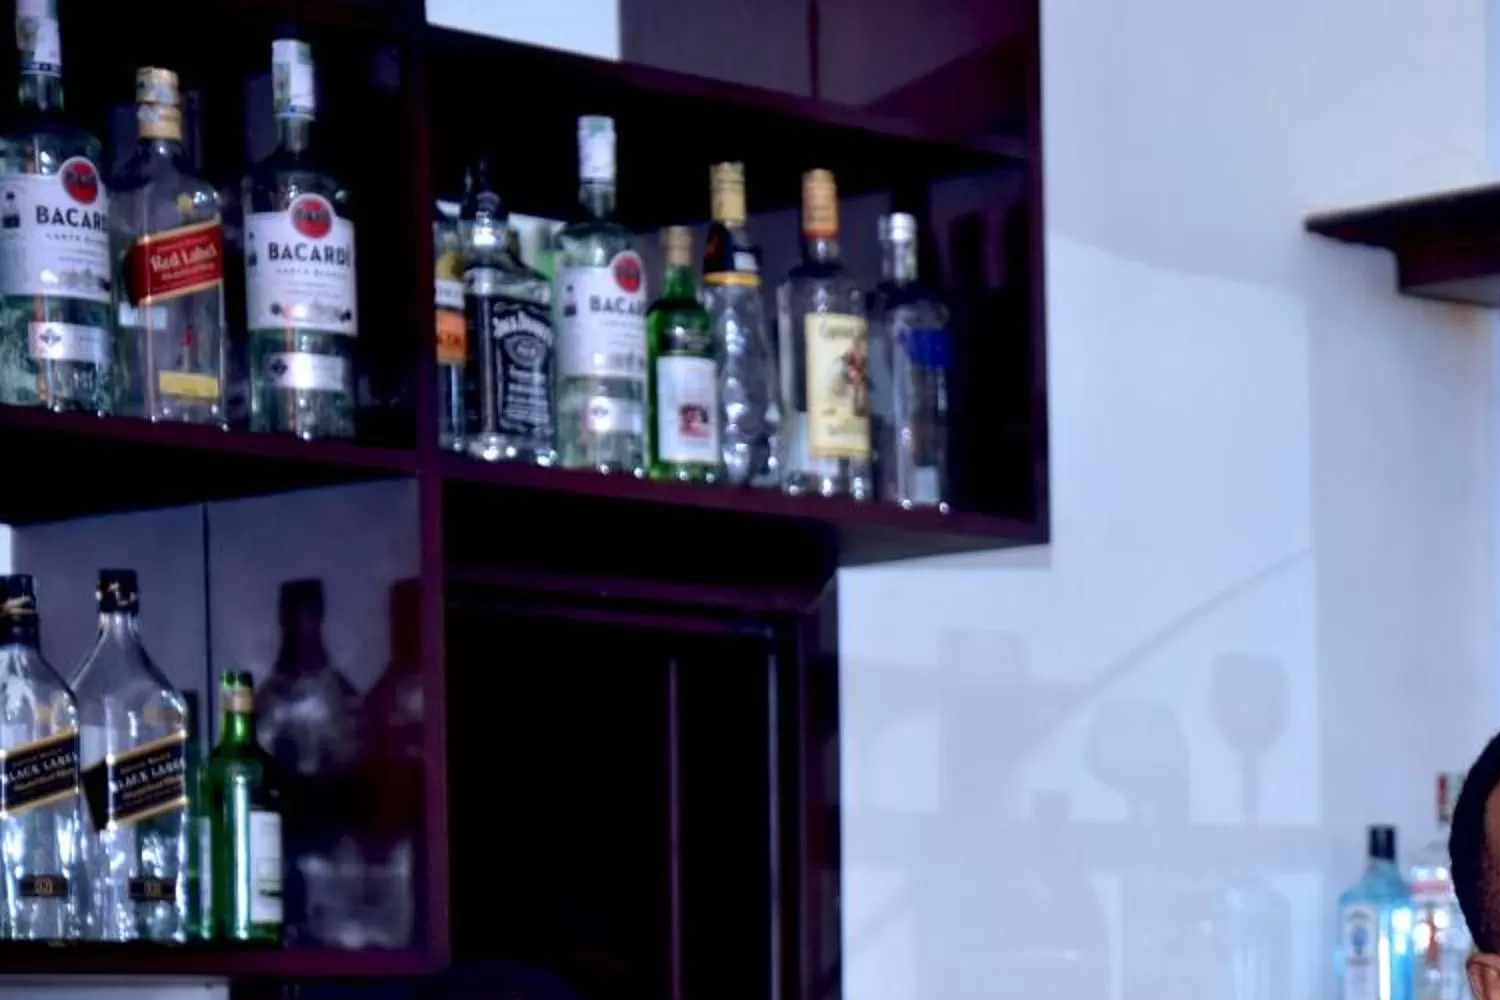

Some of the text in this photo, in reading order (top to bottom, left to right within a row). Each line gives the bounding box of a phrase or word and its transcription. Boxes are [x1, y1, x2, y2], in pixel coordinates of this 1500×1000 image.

[35, 204, 106, 231] BACAR
[4, 764, 41, 784] LACK
[110, 770, 149, 791] LACK
